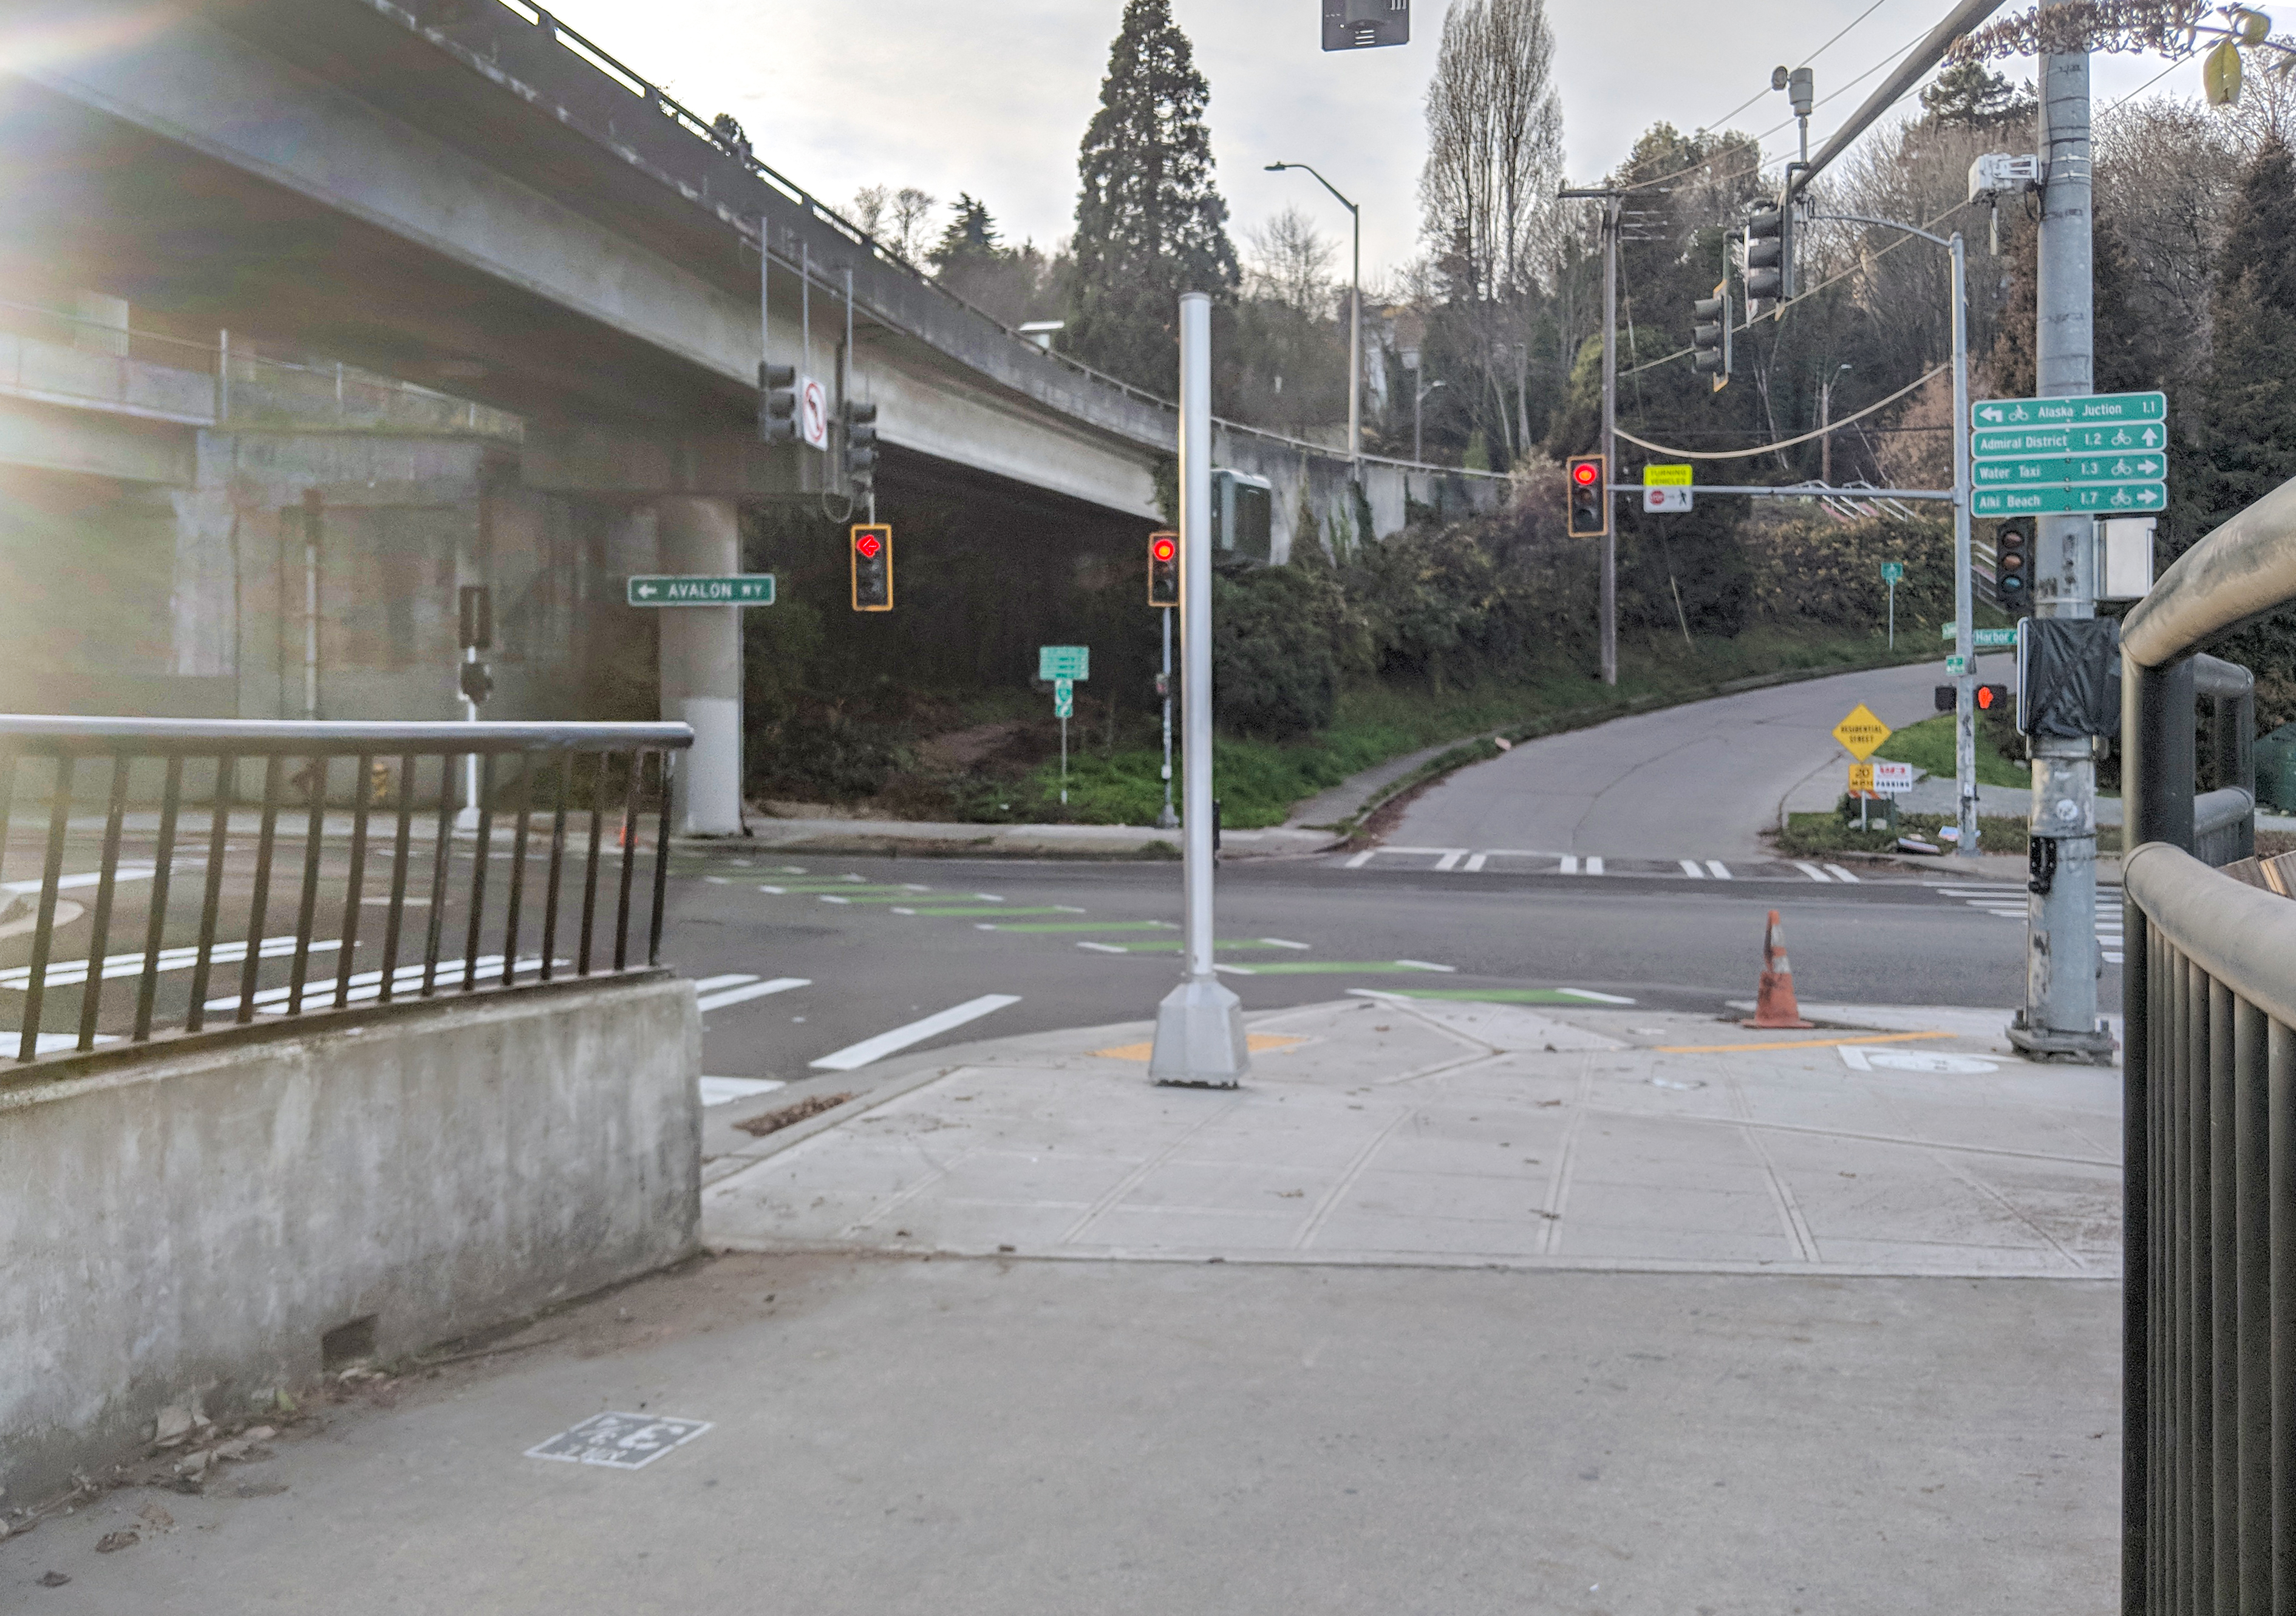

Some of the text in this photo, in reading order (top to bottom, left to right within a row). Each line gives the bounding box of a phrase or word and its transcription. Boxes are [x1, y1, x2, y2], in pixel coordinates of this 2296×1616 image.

[2038, 401, 2155, 418] Alaska Juction 1.1
[1980, 433, 2102, 450] Admiral District 1.2
[1979, 463, 2098, 480] Water Taxi 1.3
[1979, 492, 2098, 509] Alki Beach 1.7
[669, 583, 762, 599] AVALON WY
[1975, 632, 2008, 642] Harbor
[1841, 725, 1882, 733] RESIDENTIAL
[1849, 735, 1874, 744] STREET
